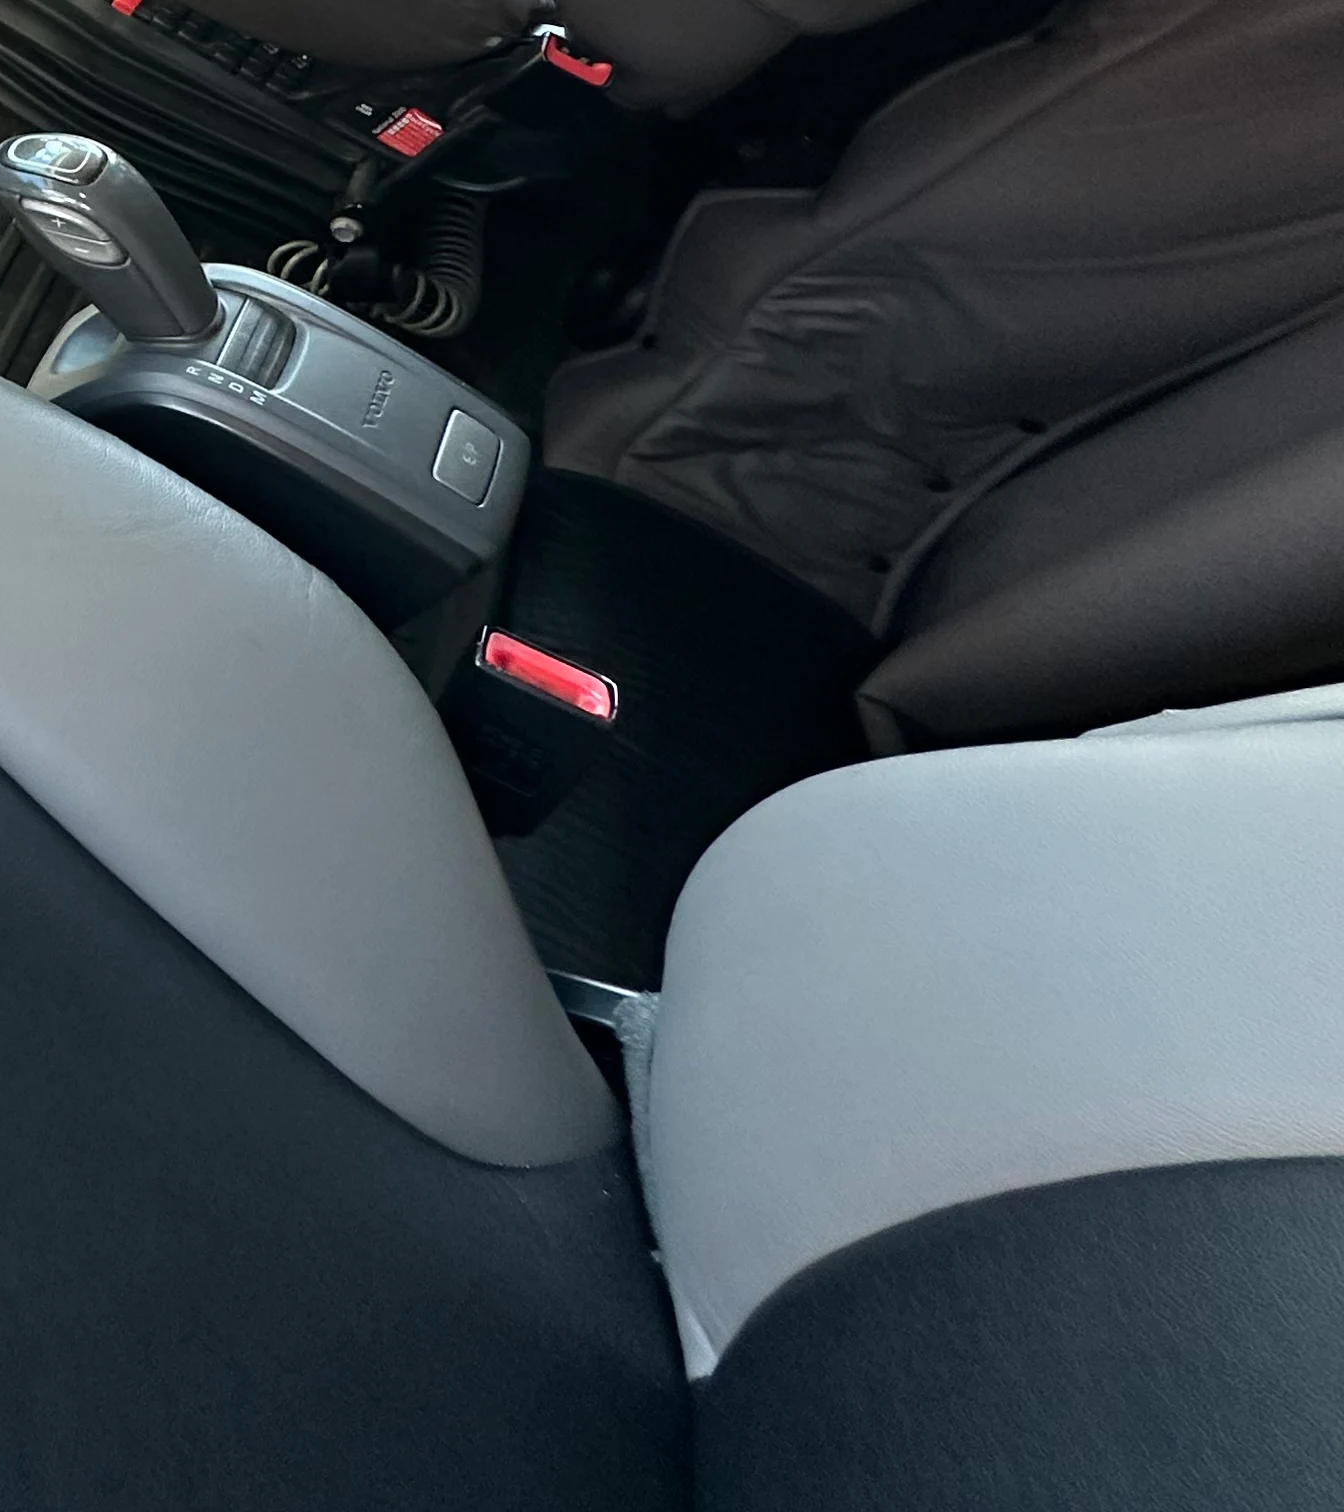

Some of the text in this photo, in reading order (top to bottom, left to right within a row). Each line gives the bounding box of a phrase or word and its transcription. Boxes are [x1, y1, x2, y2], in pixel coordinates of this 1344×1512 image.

[186, 365, 201, 376] R
[208, 373, 224, 385] N
[228, 382, 244, 393] D
[250, 390, 267, 405] M
[362, 370, 396, 428] VOLVO
